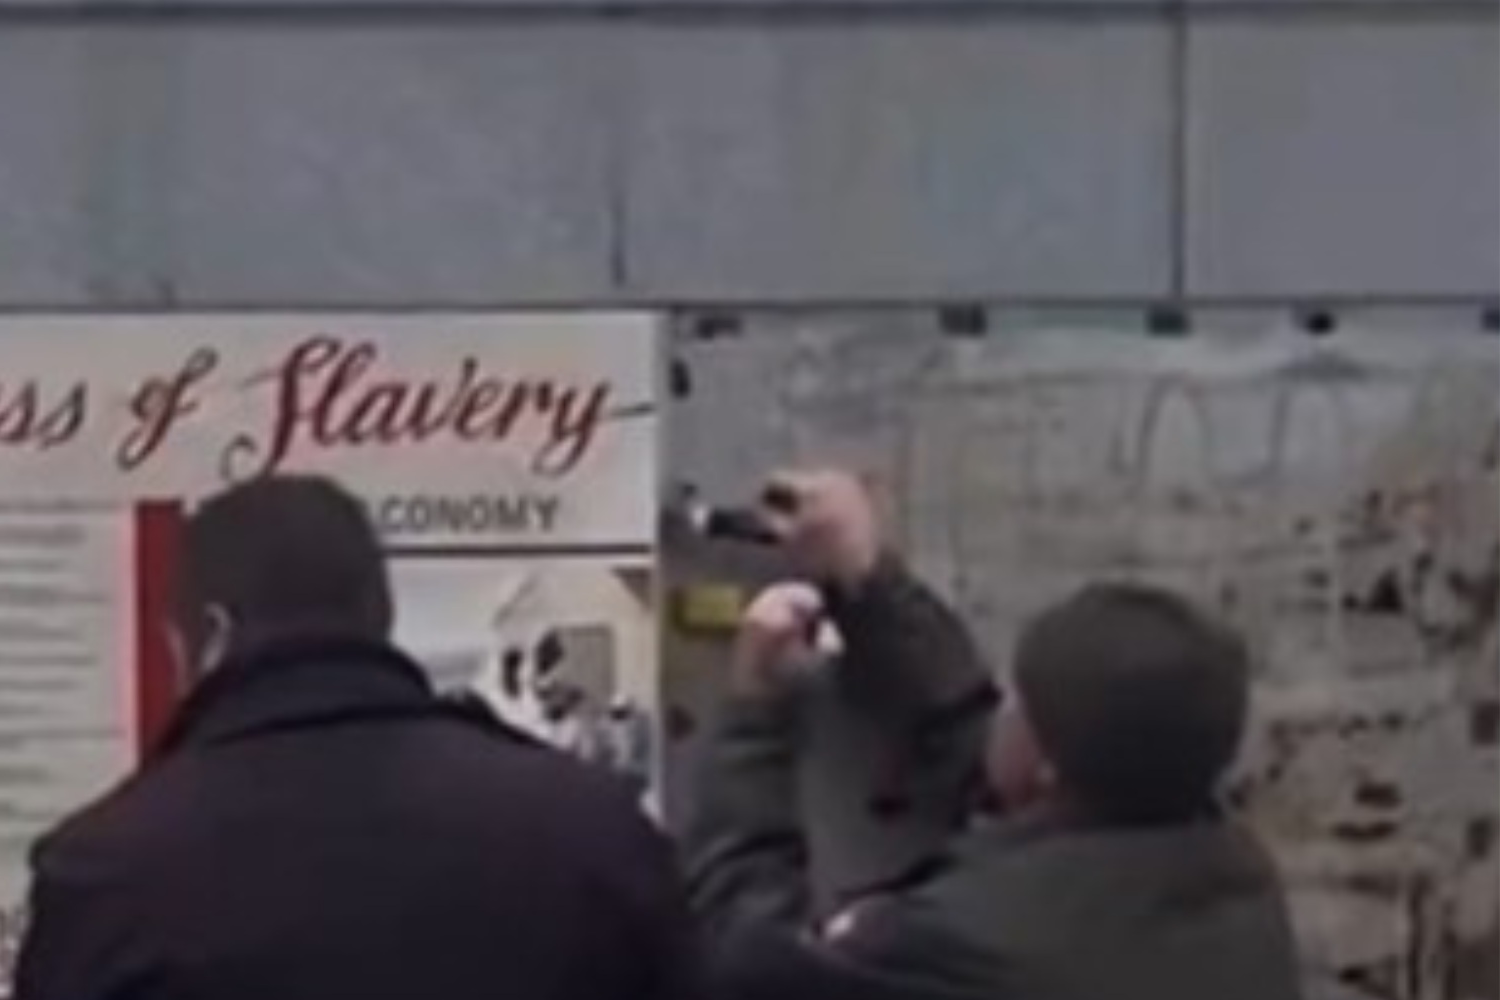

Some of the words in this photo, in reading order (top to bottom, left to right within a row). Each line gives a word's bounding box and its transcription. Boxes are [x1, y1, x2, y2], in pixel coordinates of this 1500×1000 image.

[115, 347, 219, 472] of
[220, 334, 654, 478] Slavery
[378, 496, 561, 533] CONOMY
